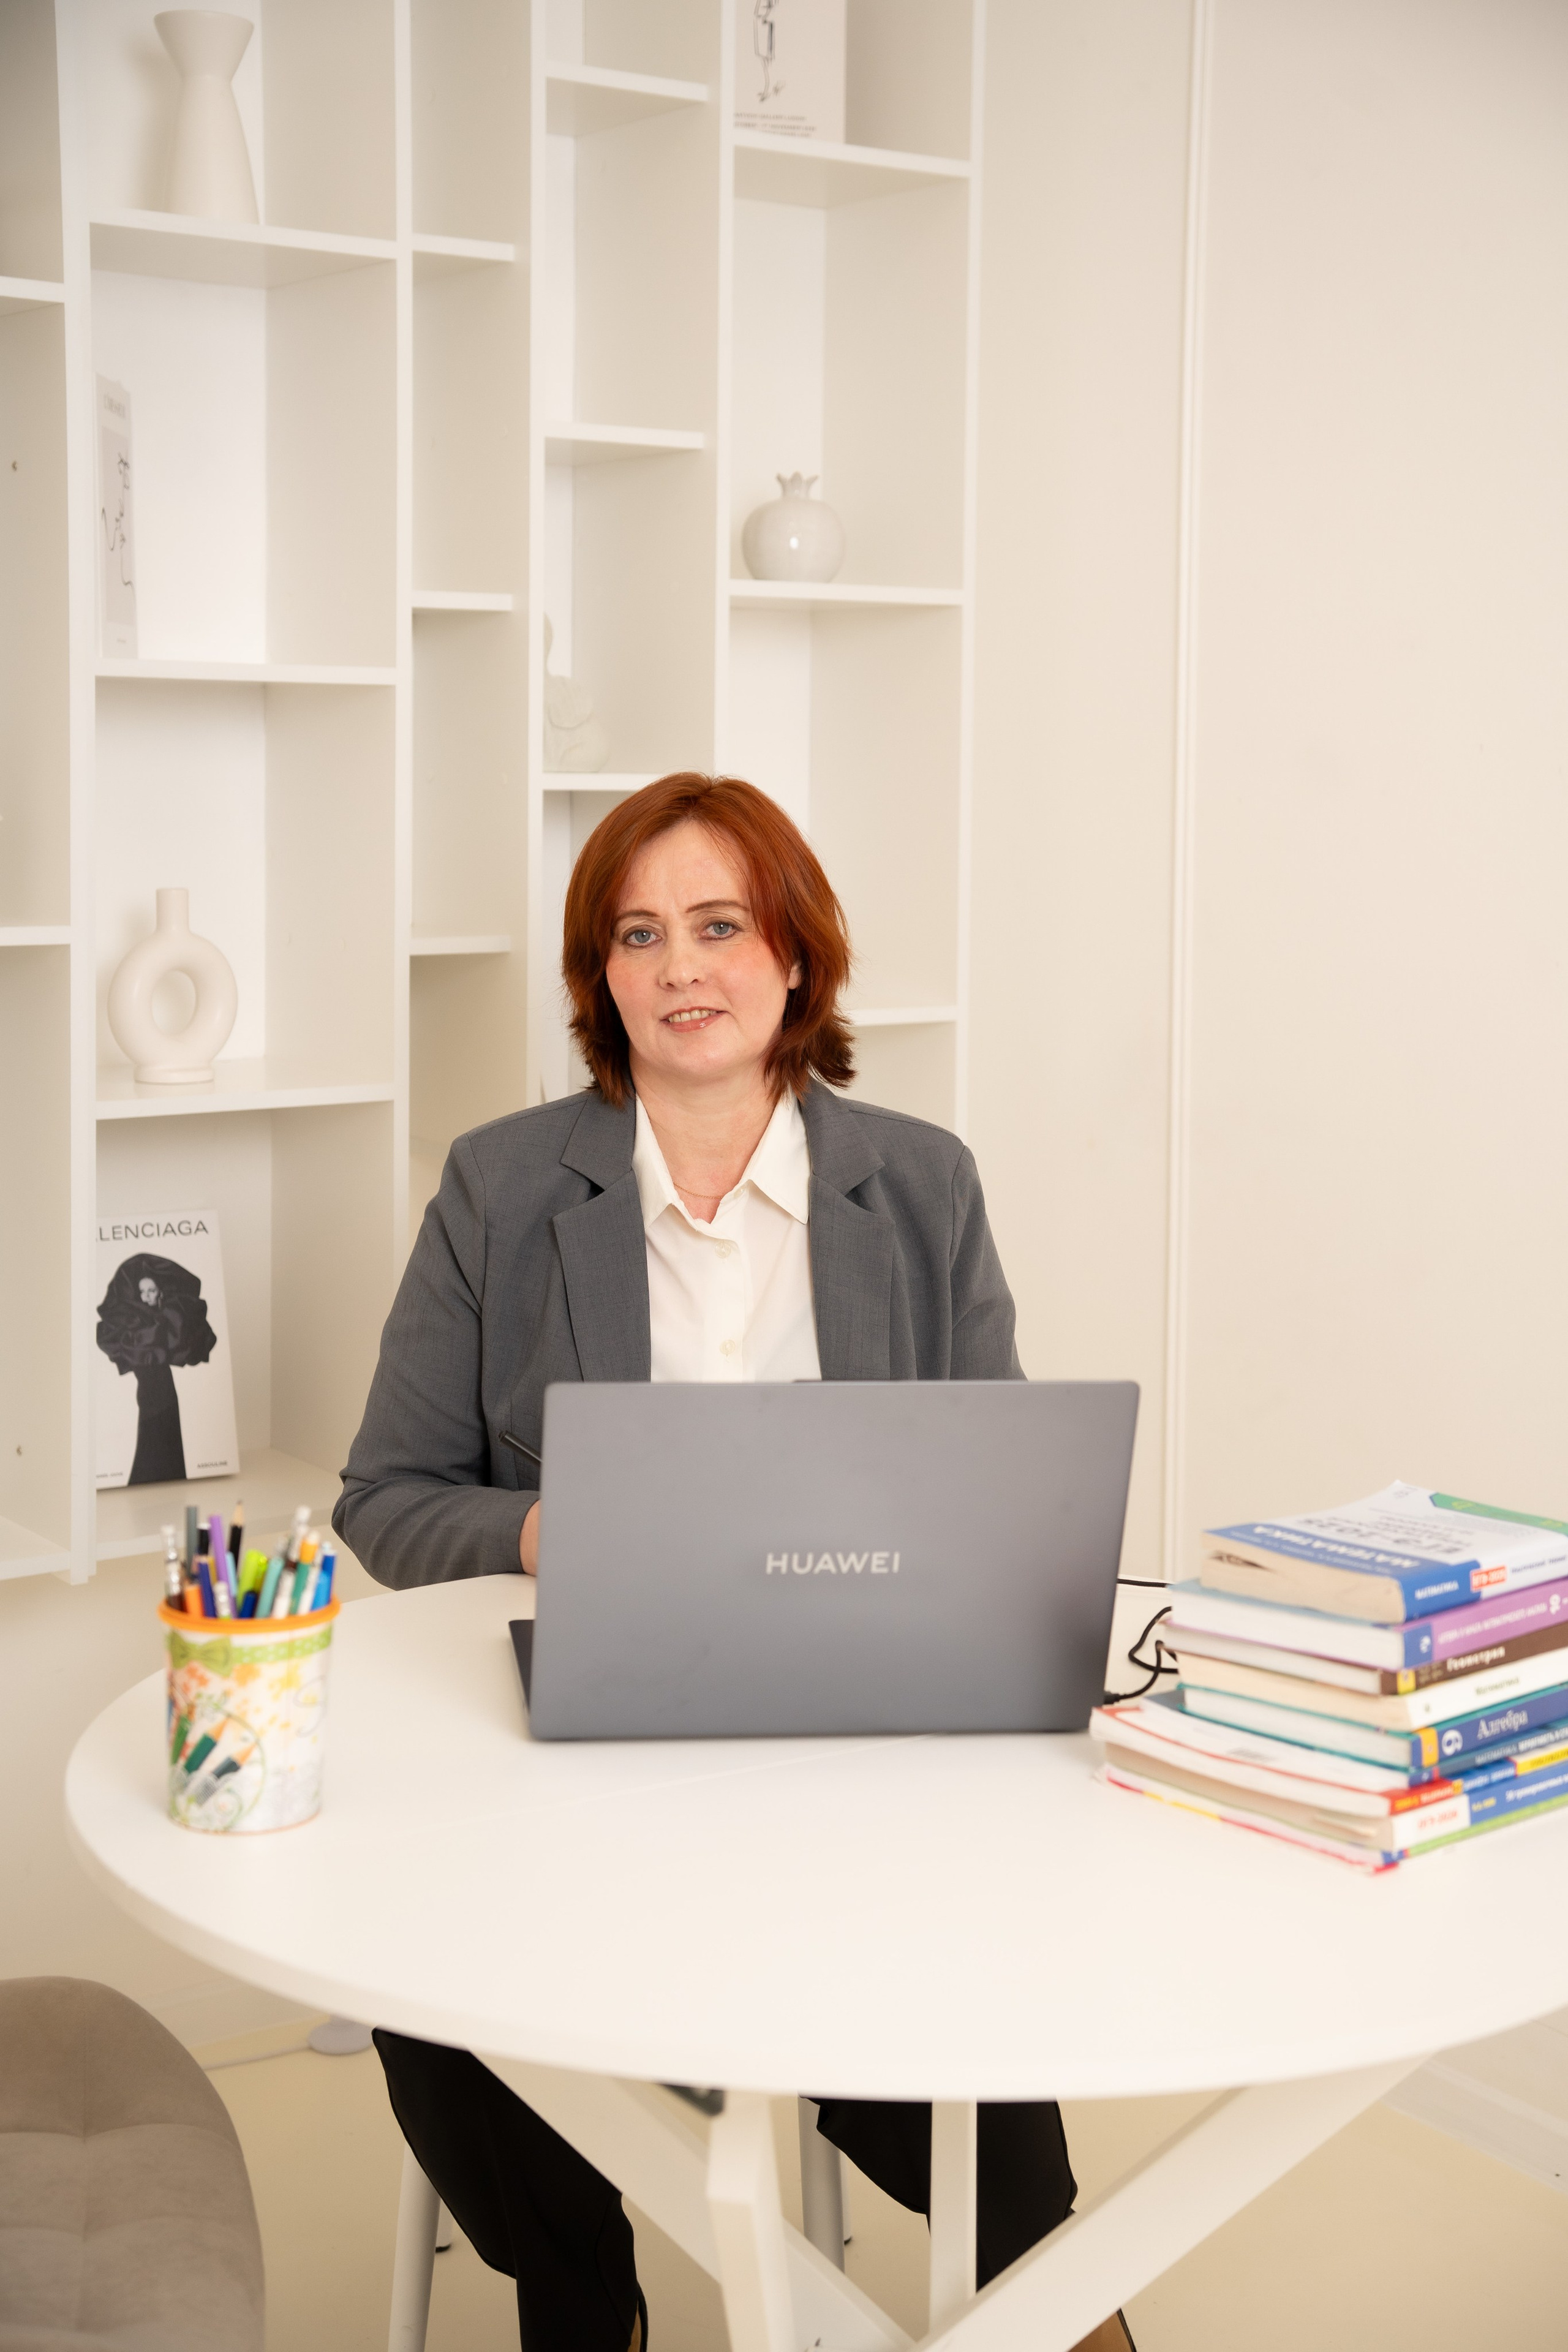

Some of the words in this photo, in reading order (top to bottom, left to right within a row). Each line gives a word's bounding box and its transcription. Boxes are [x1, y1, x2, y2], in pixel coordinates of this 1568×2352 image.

[96, 1220, 209, 1242] LENCIAGA
[766, 1551, 900, 1575] HUAWEI
[1477, 1709, 1528, 1740] Алгебра
